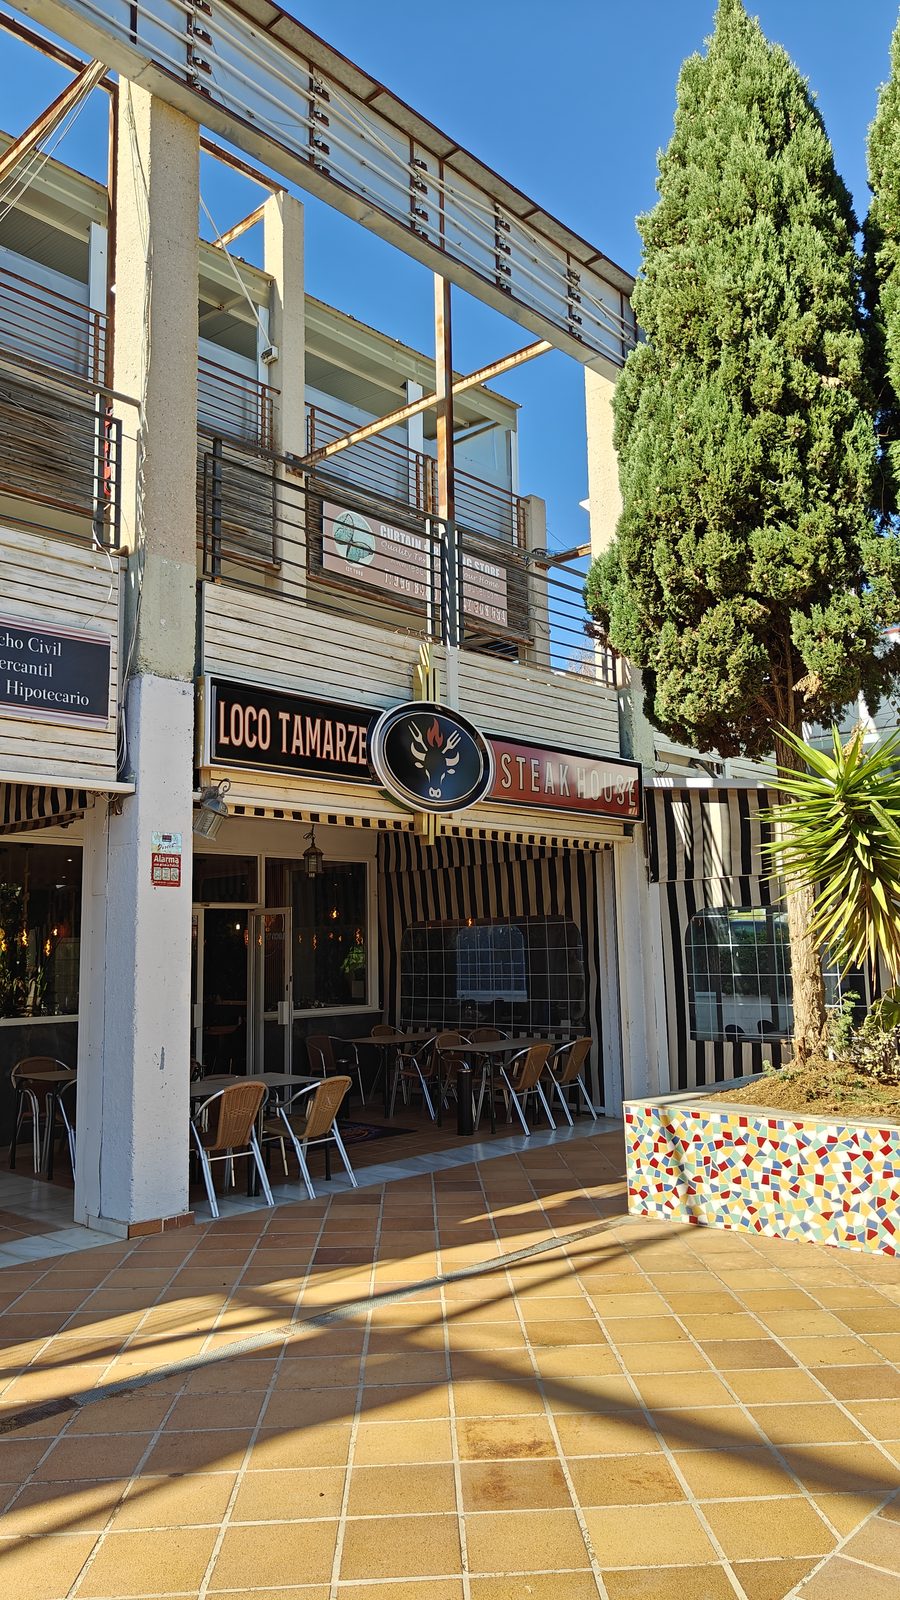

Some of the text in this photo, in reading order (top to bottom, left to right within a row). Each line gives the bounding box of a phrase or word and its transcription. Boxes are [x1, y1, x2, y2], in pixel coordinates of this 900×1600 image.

[380, 525, 421, 549] CURTAIN
[381, 540, 412, 559] Quality
[28, 637, 61, 656] Civil
[0, 659, 53, 678] ercantil
[6, 679, 89, 706] Hipotecario
[218, 700, 368, 765] LOCO TAMARZE
[501, 753, 636, 806] STEAK HOUSE
[154, 855, 180, 863] Alarma
